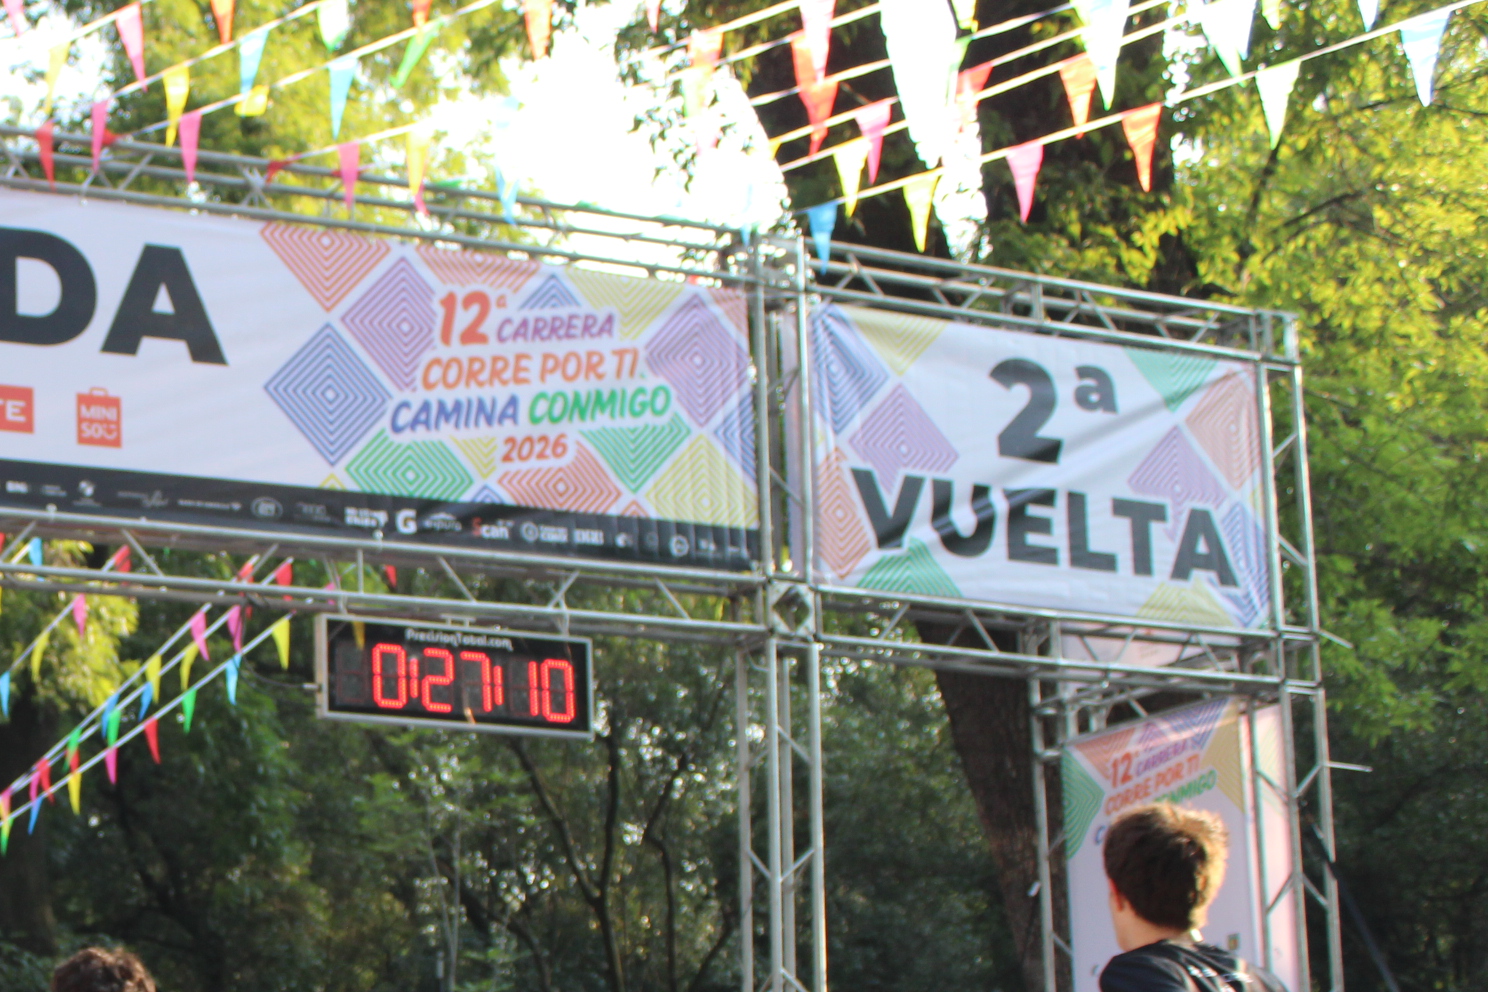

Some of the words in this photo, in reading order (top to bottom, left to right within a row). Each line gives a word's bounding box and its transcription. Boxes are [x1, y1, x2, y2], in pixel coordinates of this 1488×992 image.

[496, 312, 614, 345] CARRERA
[420, 353, 533, 391] CORRE
[539, 348, 606, 382] POR
[611, 347, 639, 379] TI
[80, 403, 118, 422] MINI
[389, 395, 520, 434] CAMINA
[528, 384, 672, 426] CONMIGO
[500, 434, 569, 464] 2026
[849, 467, 1242, 588] VUELTA
